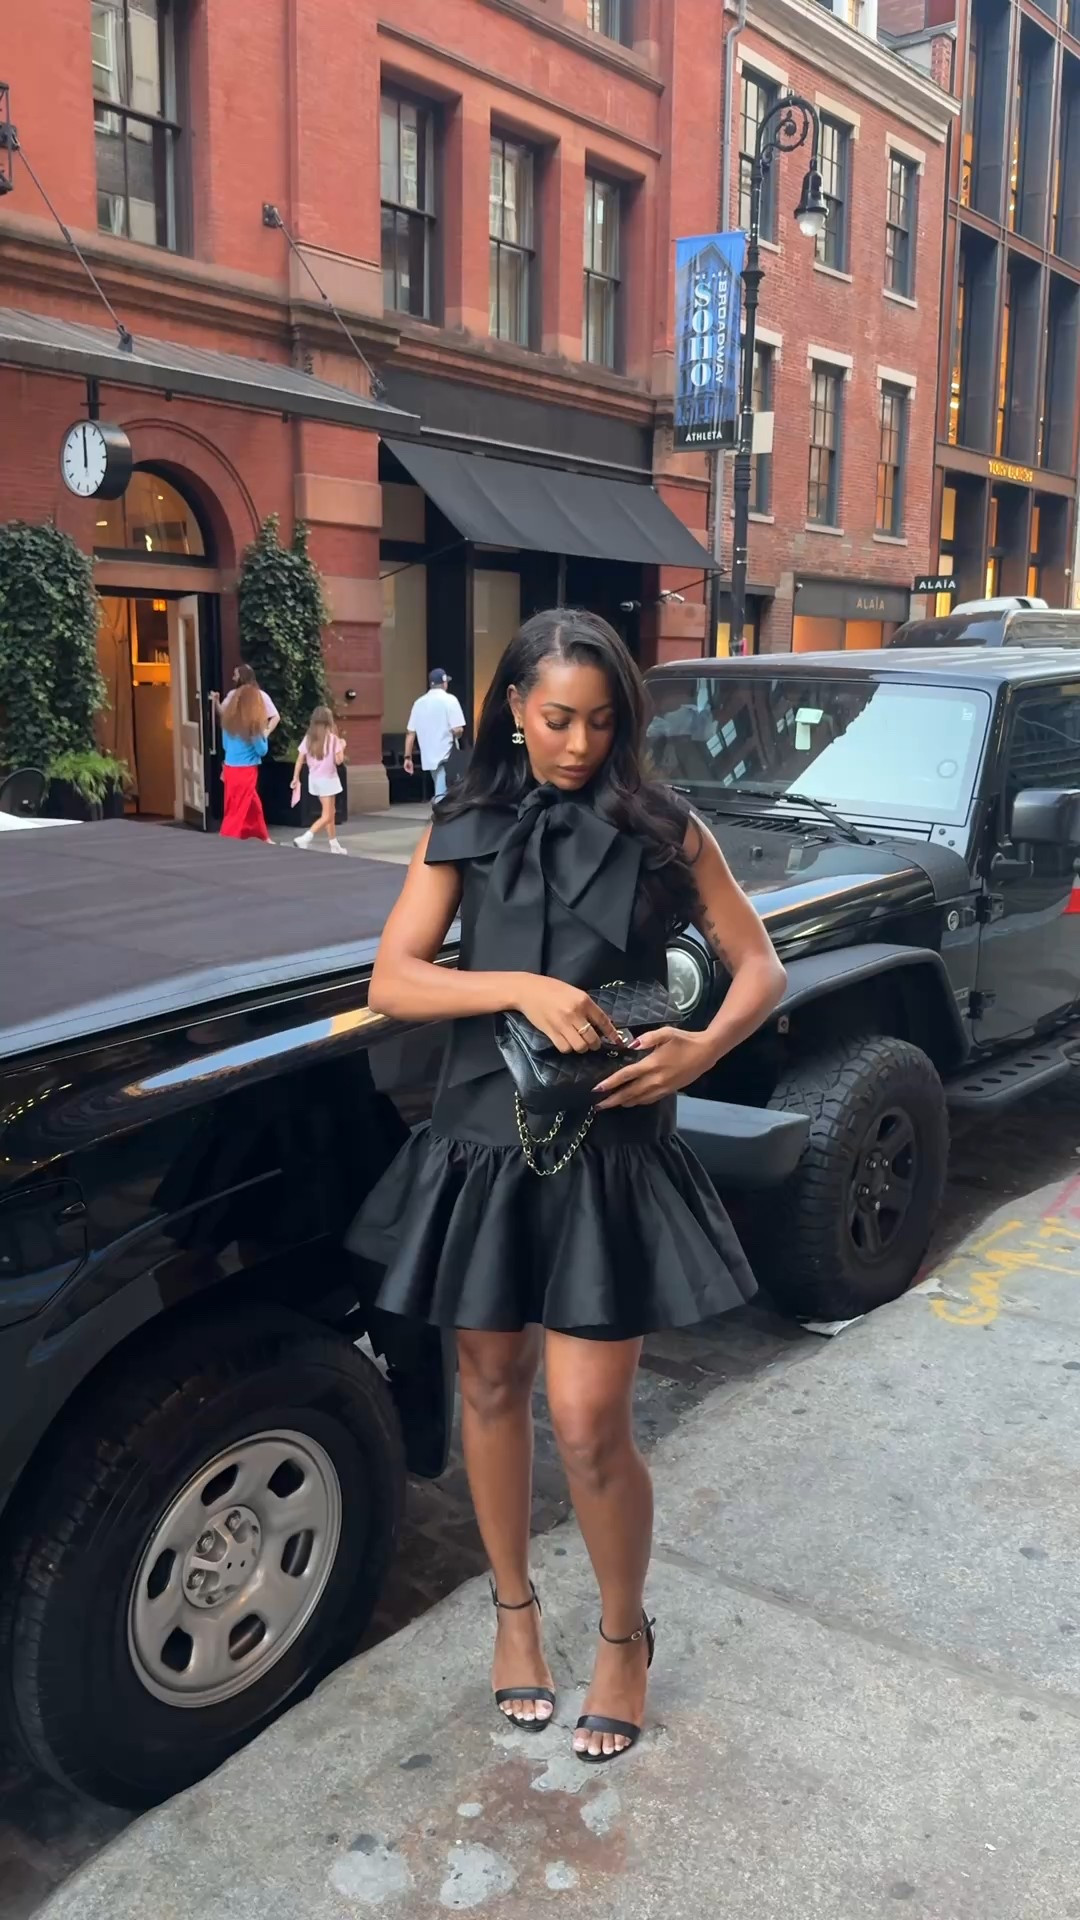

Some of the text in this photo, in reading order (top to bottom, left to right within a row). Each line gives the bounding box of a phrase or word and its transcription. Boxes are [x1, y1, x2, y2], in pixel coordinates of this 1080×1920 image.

[690, 281, 714, 387] SOHO
[716, 280, 728, 384] BROADWAY
[685, 431, 723, 442] ATHLETA
